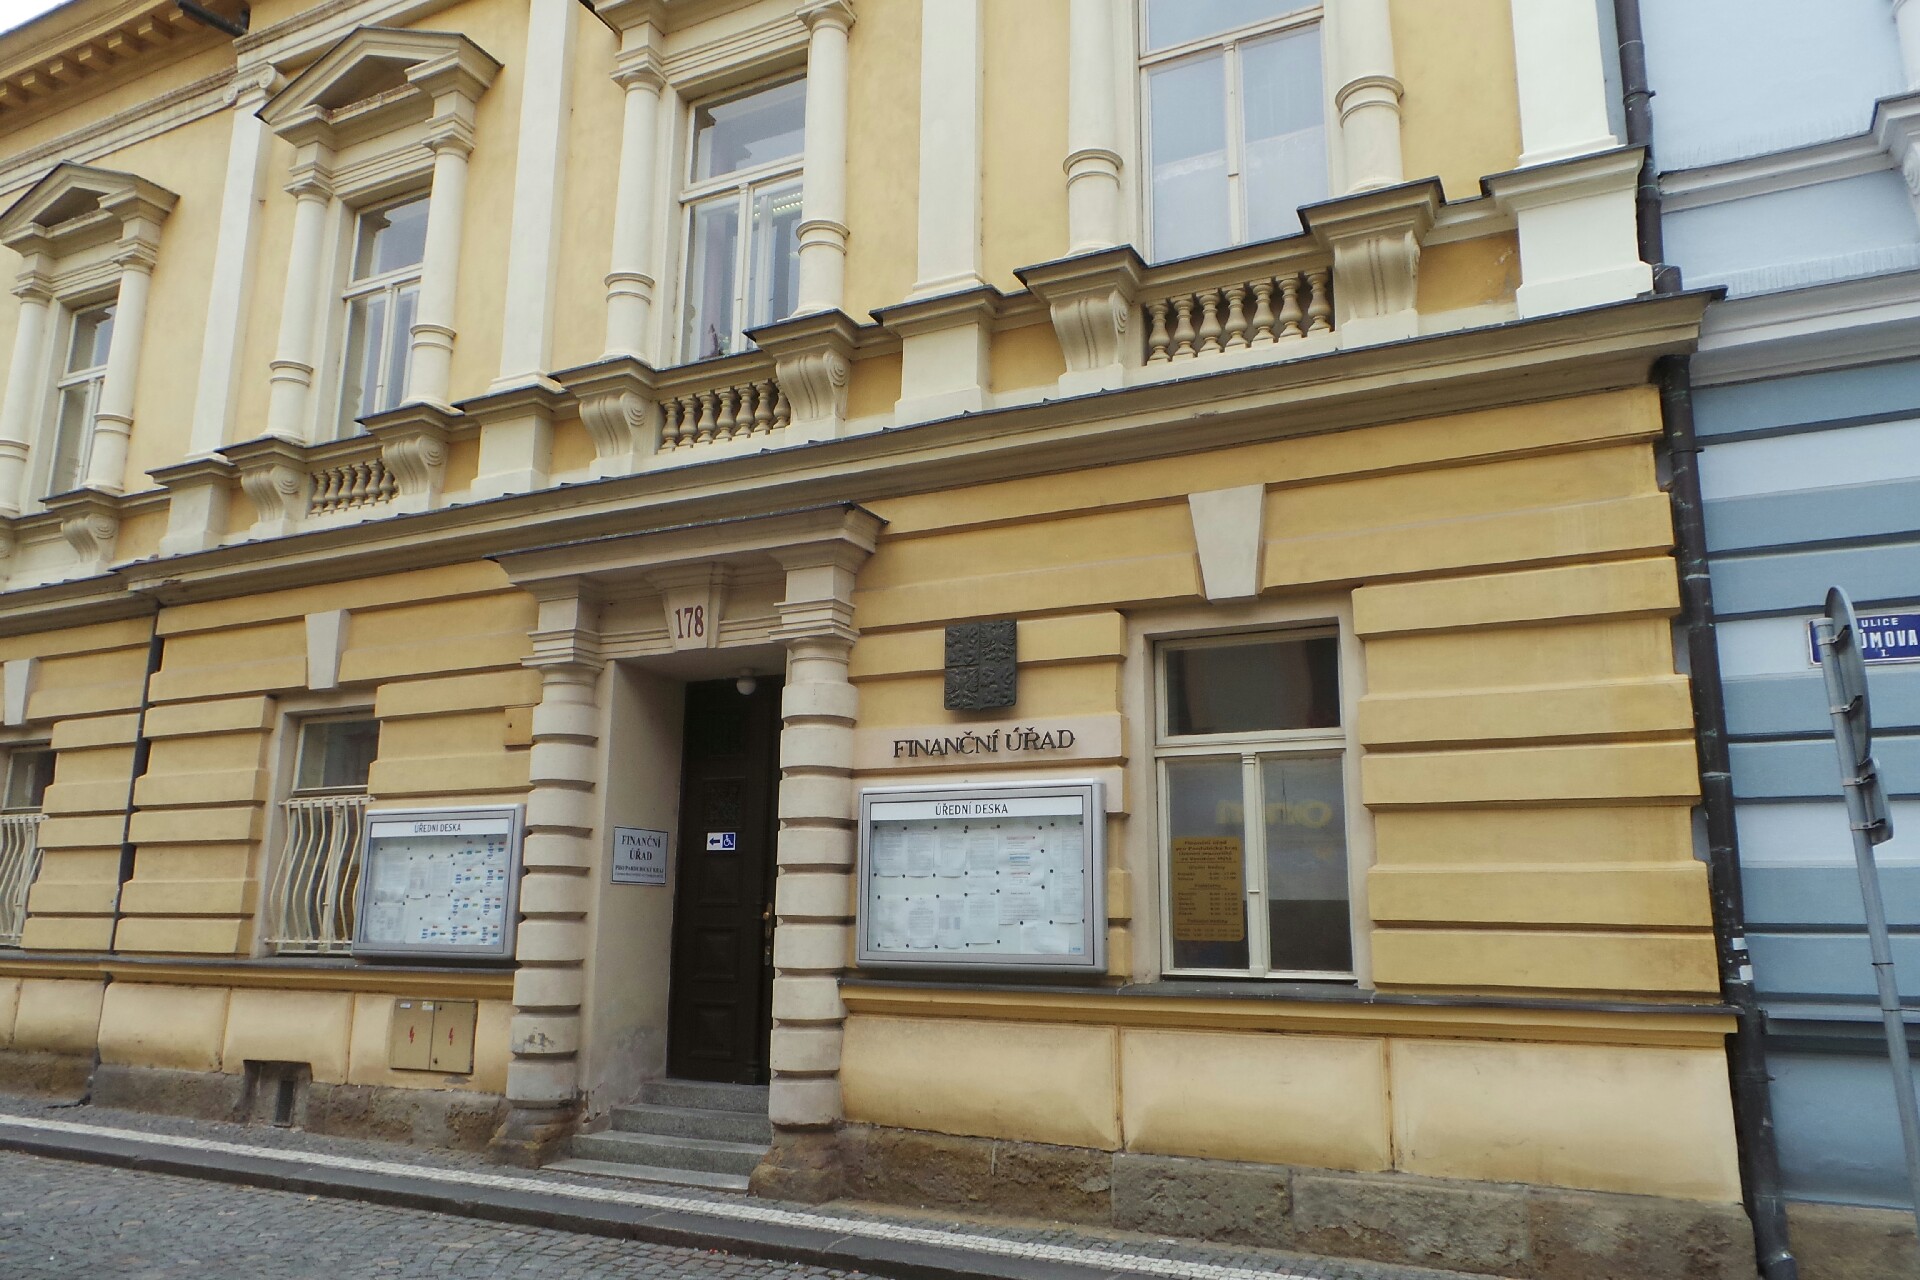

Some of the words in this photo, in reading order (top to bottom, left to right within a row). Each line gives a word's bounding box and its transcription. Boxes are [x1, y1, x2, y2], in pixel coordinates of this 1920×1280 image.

[675, 605, 704, 639] 178
[1861, 617, 1899, 628] ULICE
[893, 729, 1001, 758] FINANČNÍ
[1004, 726, 1076, 752] ÚŘAD
[935, 801, 972, 816] ÚŘEDNÍ
[975, 803, 1009, 815] DESKA
[440, 823, 461, 832] DESKA
